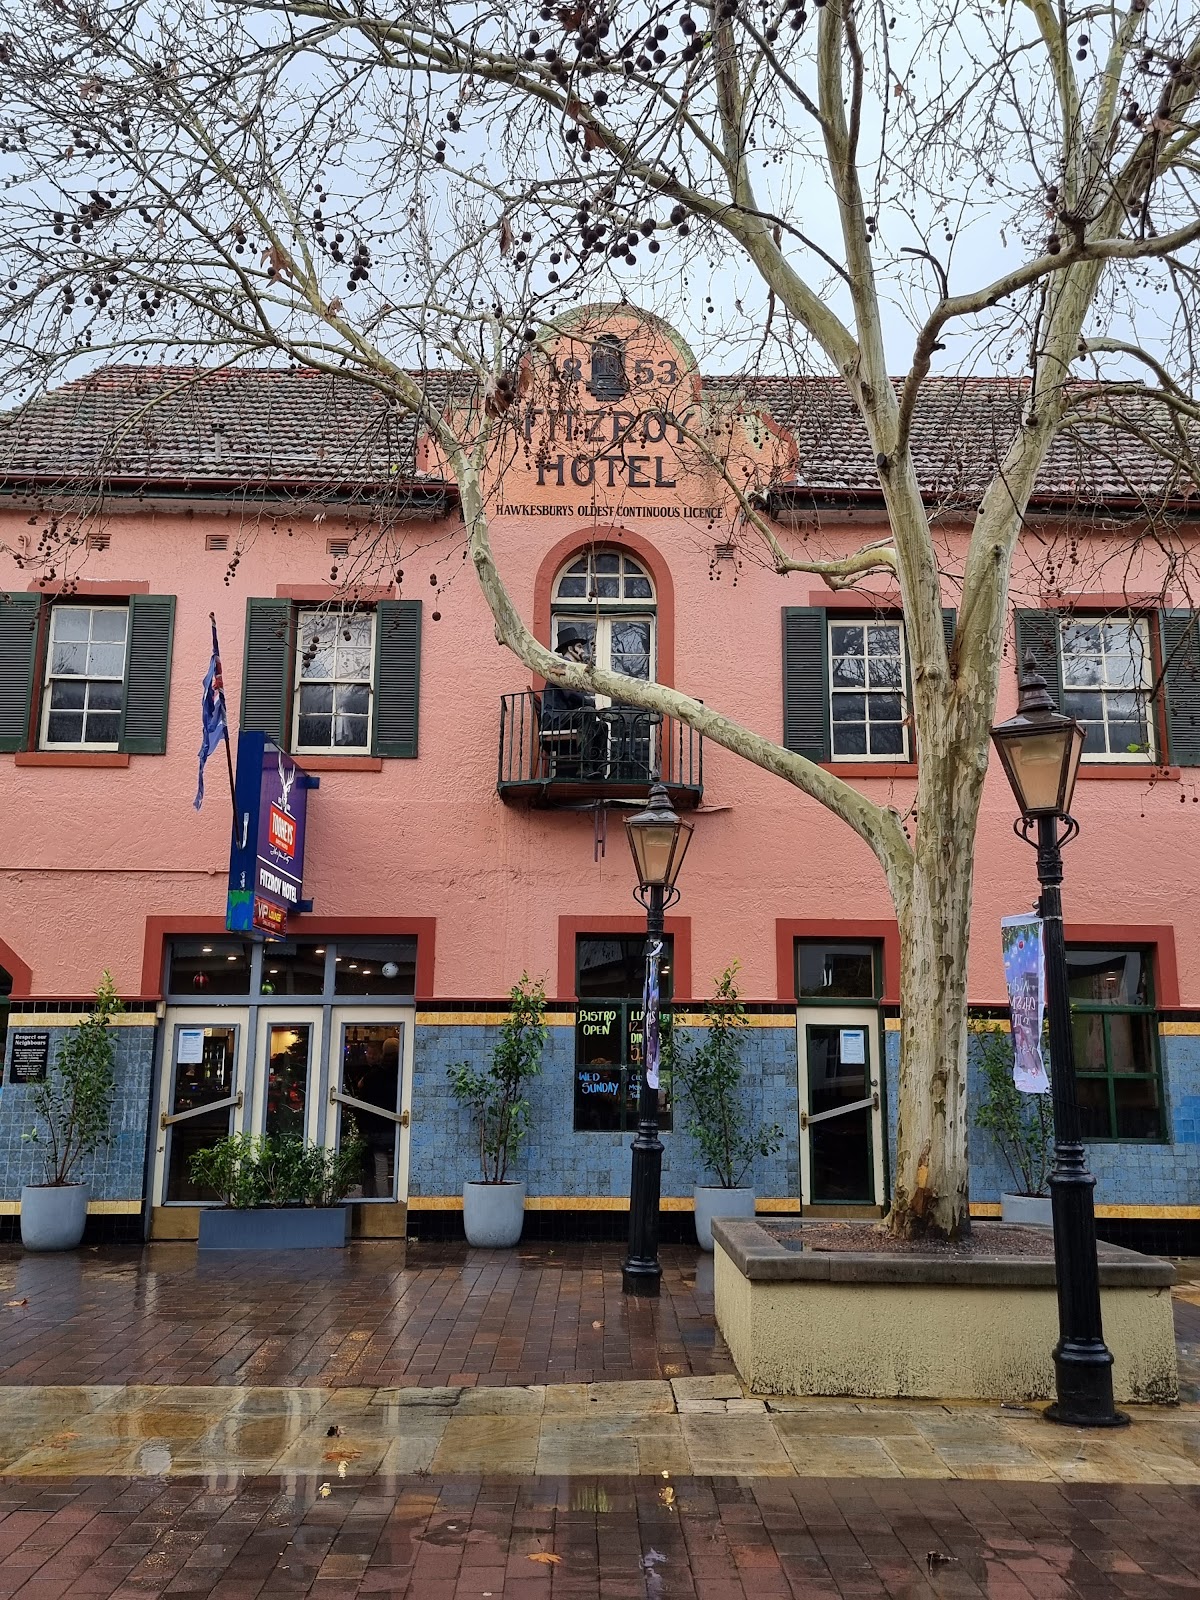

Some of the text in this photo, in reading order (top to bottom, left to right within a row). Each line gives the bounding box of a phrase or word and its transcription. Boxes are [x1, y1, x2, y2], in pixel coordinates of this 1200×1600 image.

[535, 453, 677, 487] HOTEL
[577, 505, 615, 517] OLDEST
[616, 506, 680, 518] CONTINUOUS
[683, 507, 723, 519] LICENCE
[272, 812, 294, 846] TOOHEYS
[260, 867, 282, 895] FITZROY
[281, 880, 298, 904] HOTEL
[578, 1010, 617, 1024] BISTRO
[583, 1022, 611, 1036] OPEN
[579, 1072, 600, 1082] WED
[581, 1082, 619, 1096] SUNDAY
